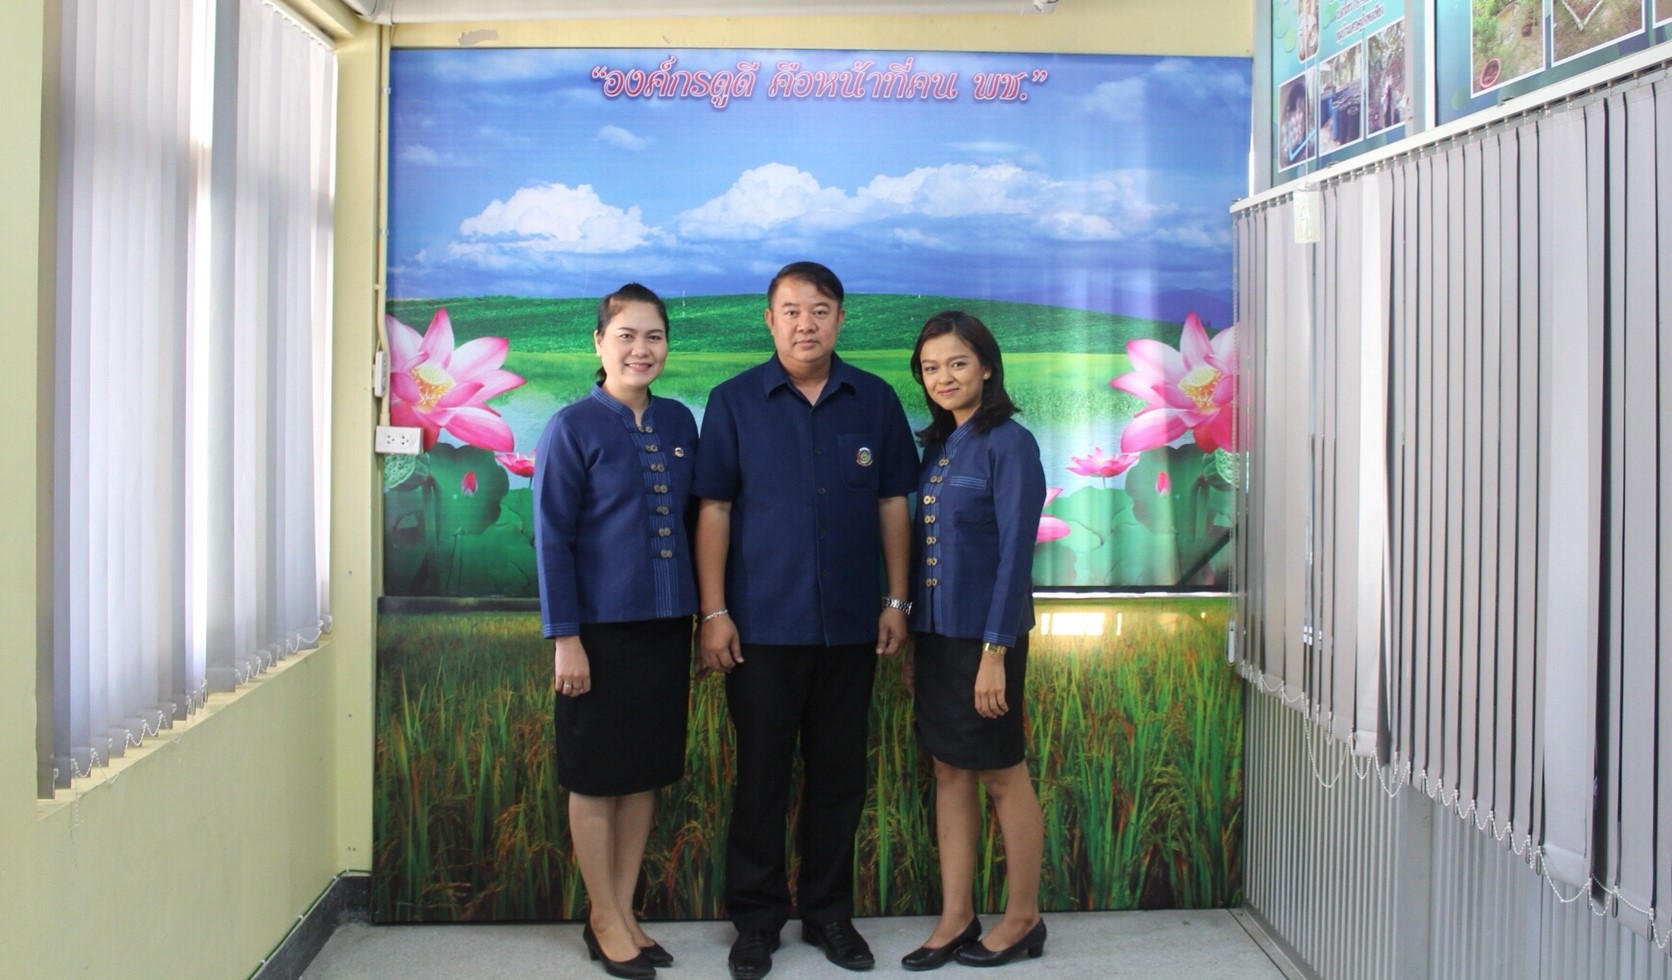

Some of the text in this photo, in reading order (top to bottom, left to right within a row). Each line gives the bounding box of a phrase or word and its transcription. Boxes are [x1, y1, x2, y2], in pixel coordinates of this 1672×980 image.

[592, 55, 1048, 108] “องค์กรดูดี คือหน้าที่คน พช.”
